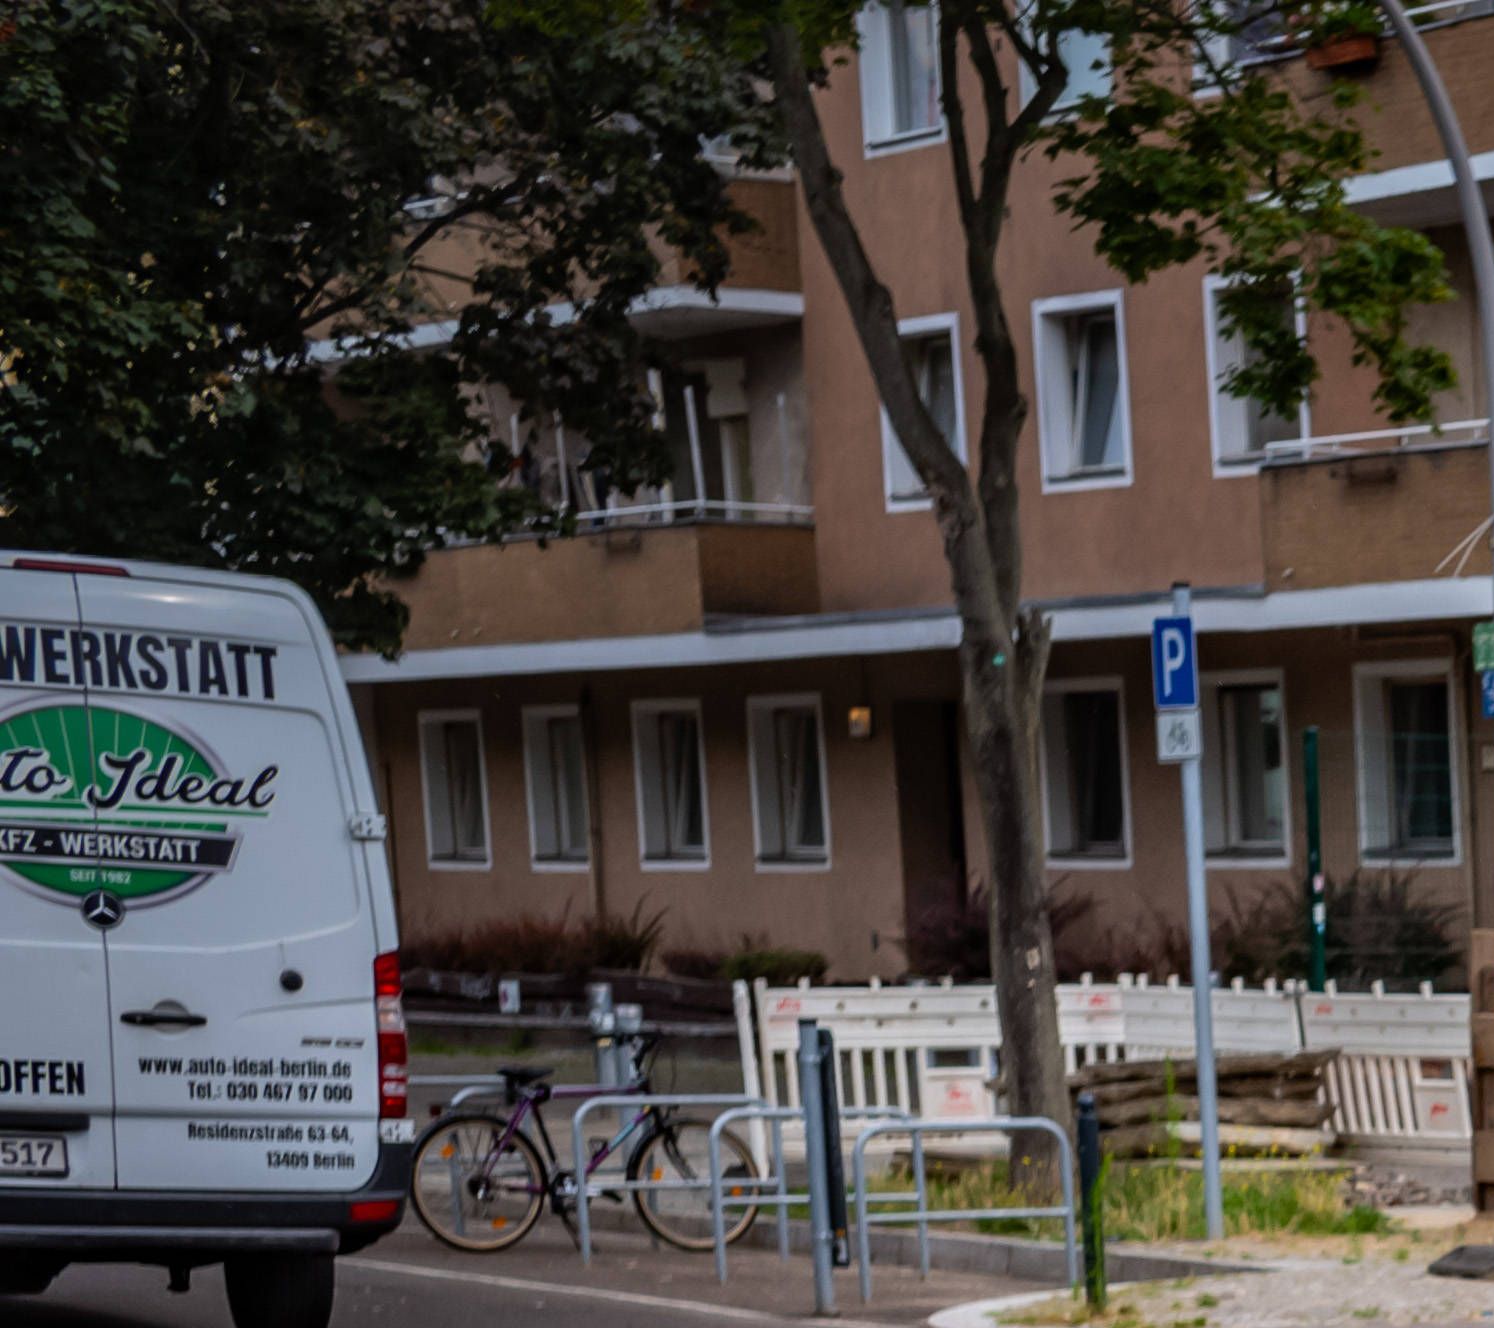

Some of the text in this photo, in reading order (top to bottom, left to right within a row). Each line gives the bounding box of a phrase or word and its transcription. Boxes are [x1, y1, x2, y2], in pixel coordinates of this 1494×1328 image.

[0, 626, 278, 700] WERKSTATT
[1160, 626, 1186, 698] P
[86, 748, 280, 809] Ideal
[60, 830, 202, 863] WERKSTATT
[226, 1082, 258, 1102] 030
[1, 1140, 55, 1167] 517
[313, 1152, 355, 1170] Berlin
